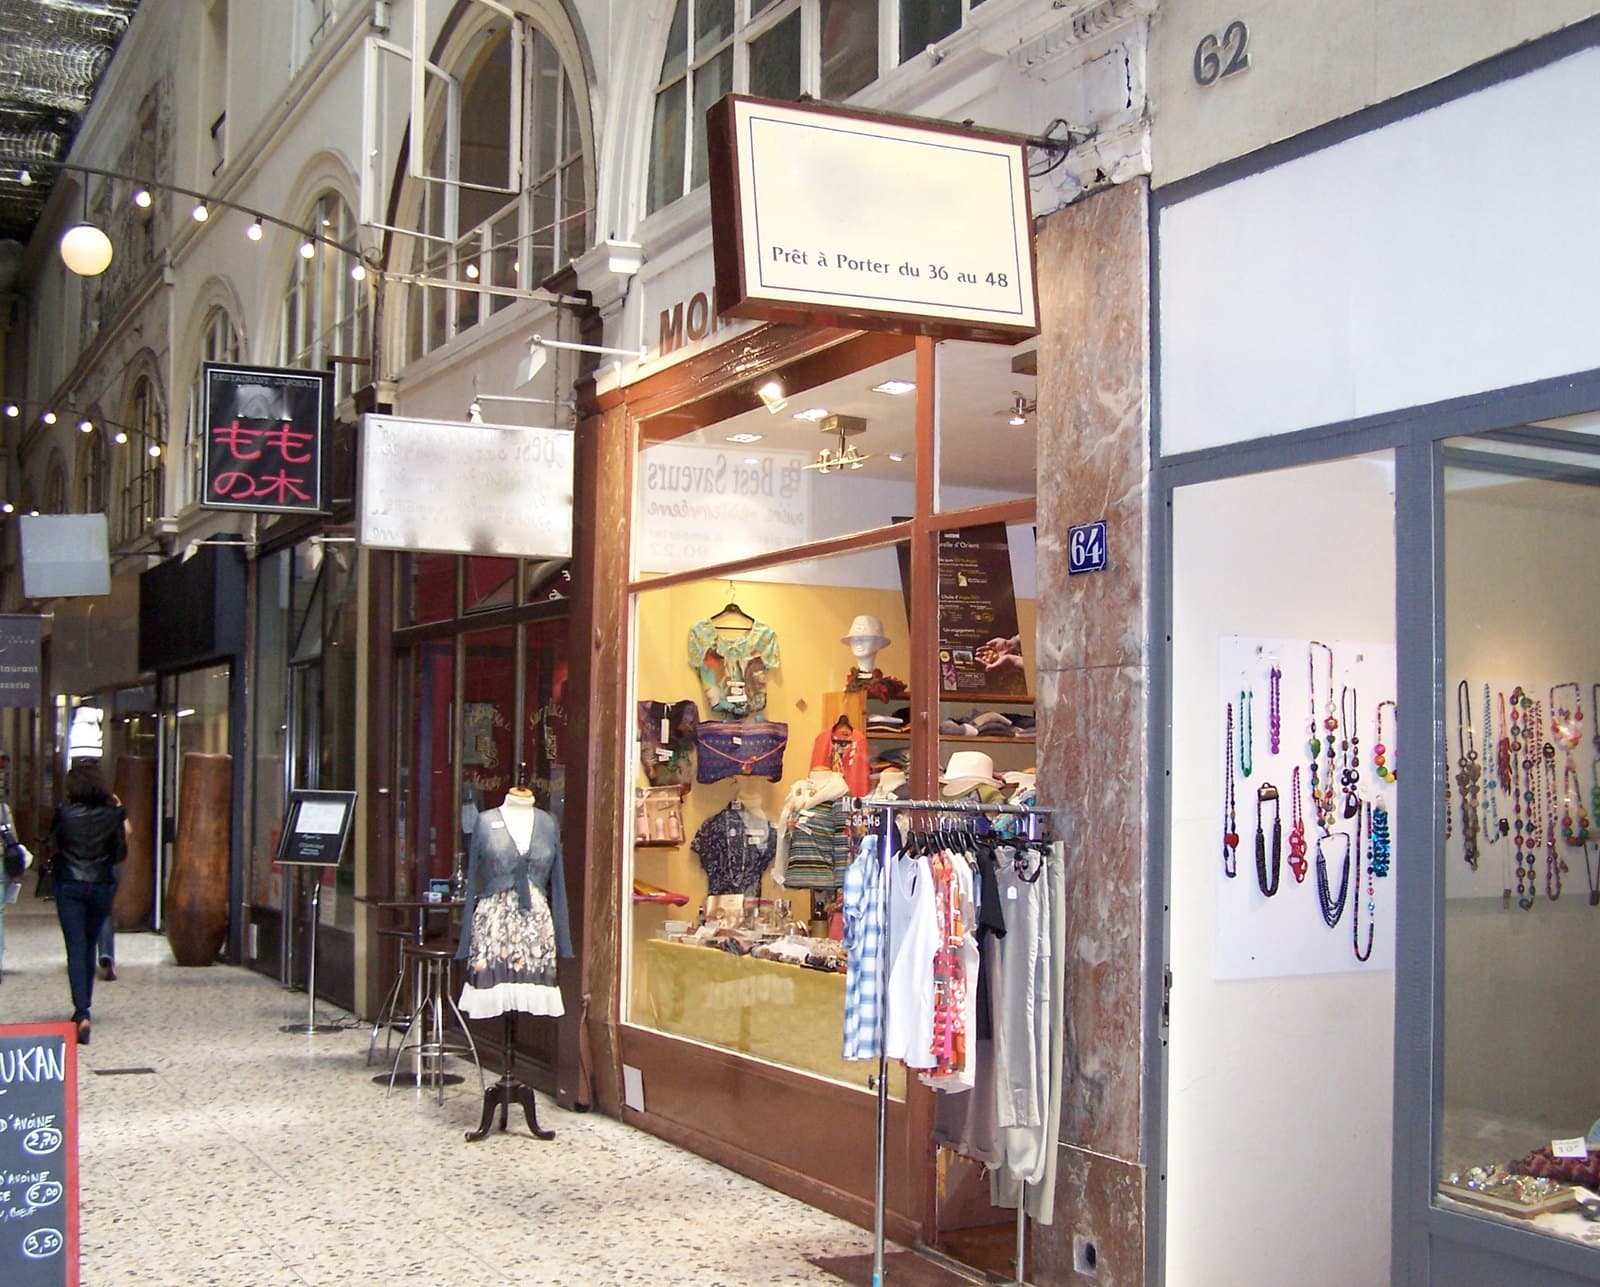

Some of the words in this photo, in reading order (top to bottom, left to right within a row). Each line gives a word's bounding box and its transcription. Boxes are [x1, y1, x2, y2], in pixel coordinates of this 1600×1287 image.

[1194, 21, 1248, 86] 62
[772, 246, 808, 265] Prêt
[817, 252, 828, 267] à
[837, 254, 890, 274] Porter
[899, 262, 920, 277] du
[929, 265, 949, 280] 36
[957, 271, 977, 284] au
[985, 272, 1009, 287] 48
[212, 419, 314, 463] もも
[214, 468, 311, 504] の木
[1071, 527, 1102, 566] 64
[30, 1185, 59, 1203] 6,00
